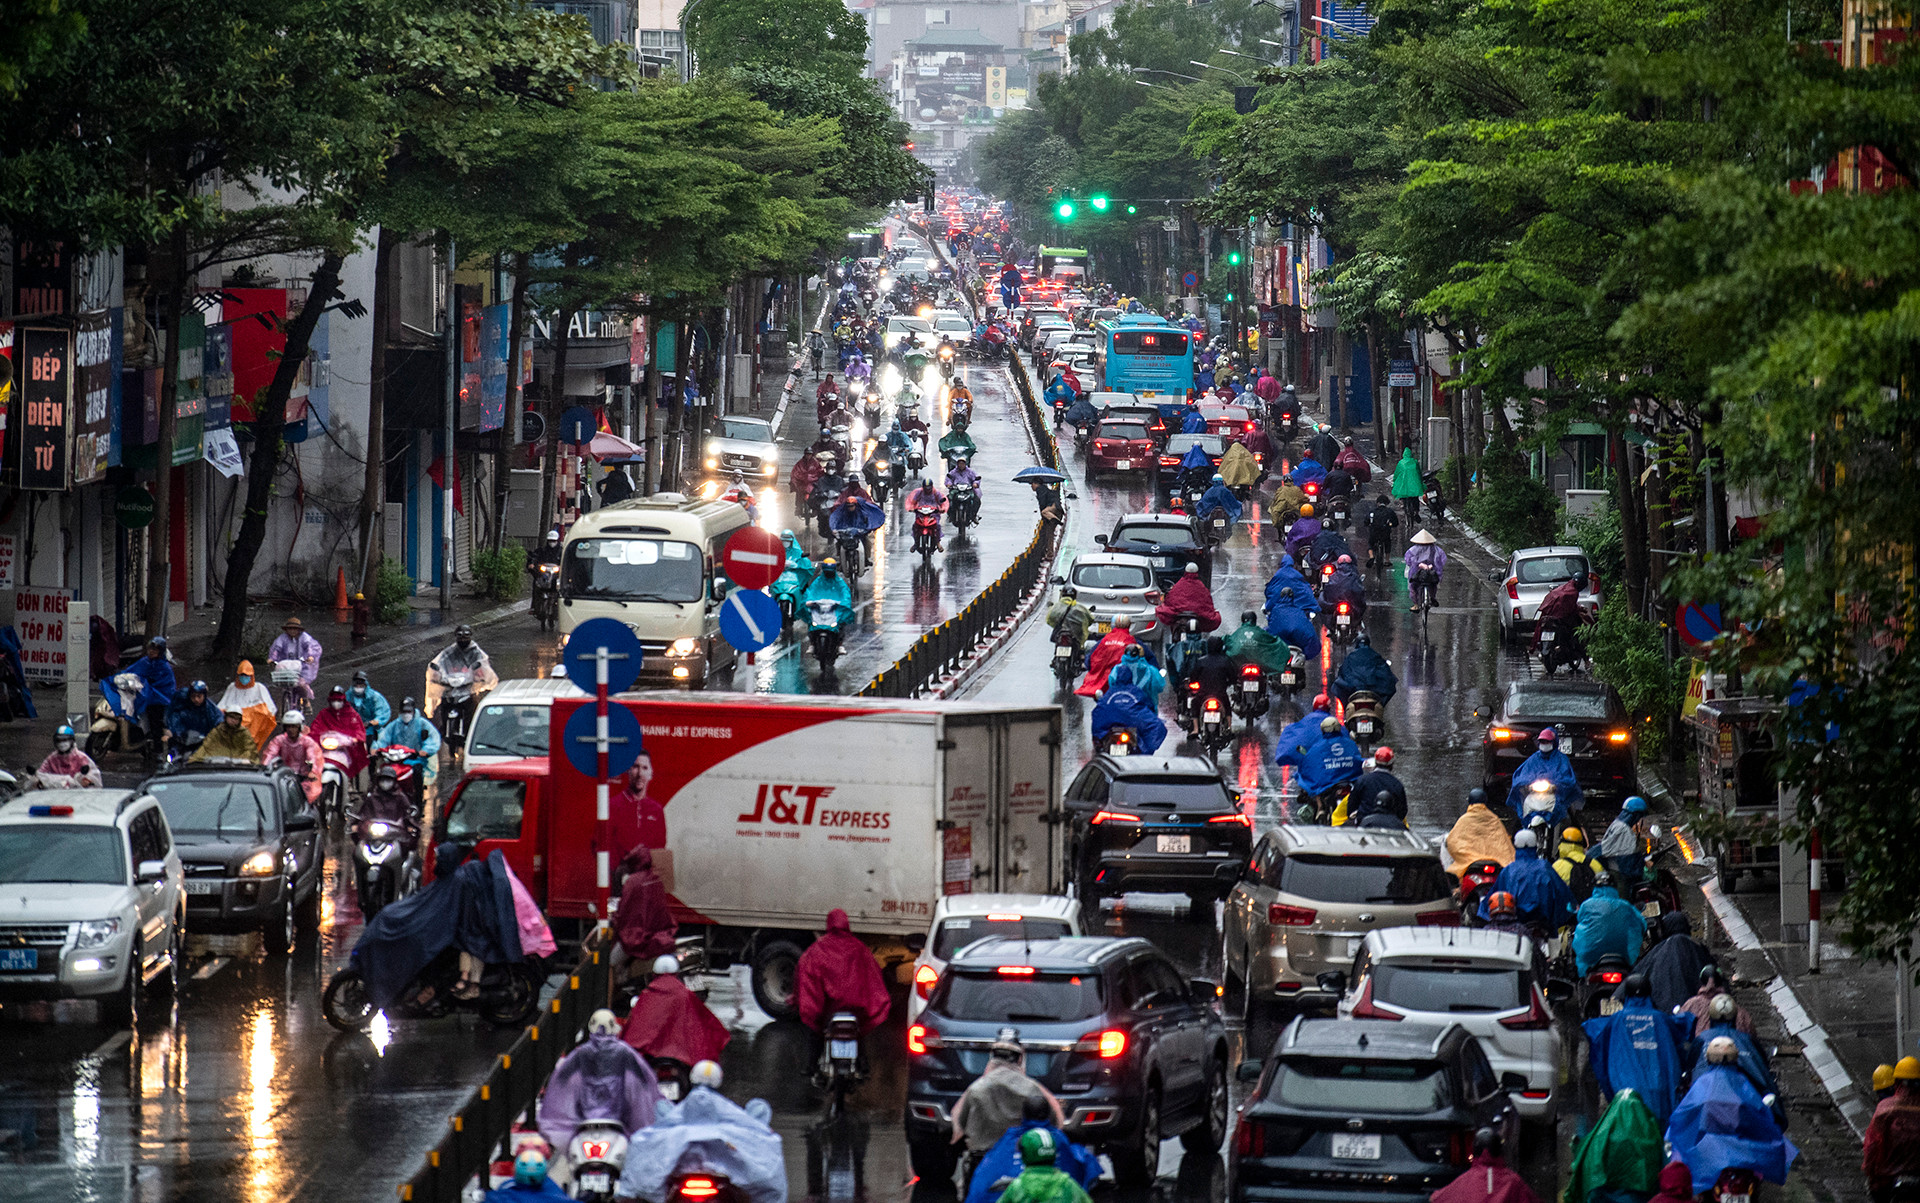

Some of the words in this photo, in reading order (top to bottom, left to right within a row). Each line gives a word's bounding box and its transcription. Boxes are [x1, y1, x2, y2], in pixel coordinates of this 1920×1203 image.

[1146, 336, 1155, 344] 01
[32, 349, 60, 381] BẾP
[27, 397, 62, 432] ĐIỆN
[35, 440, 55, 471] TỪ
[17, 589, 40, 612] BÚN
[21, 617, 43, 641] TÓP
[671, 725, 689, 737] J&T
[690, 726, 732, 738] EXPRESS
[737, 784, 836, 826] J&T
[820, 809, 891, 830] EXPRESS
